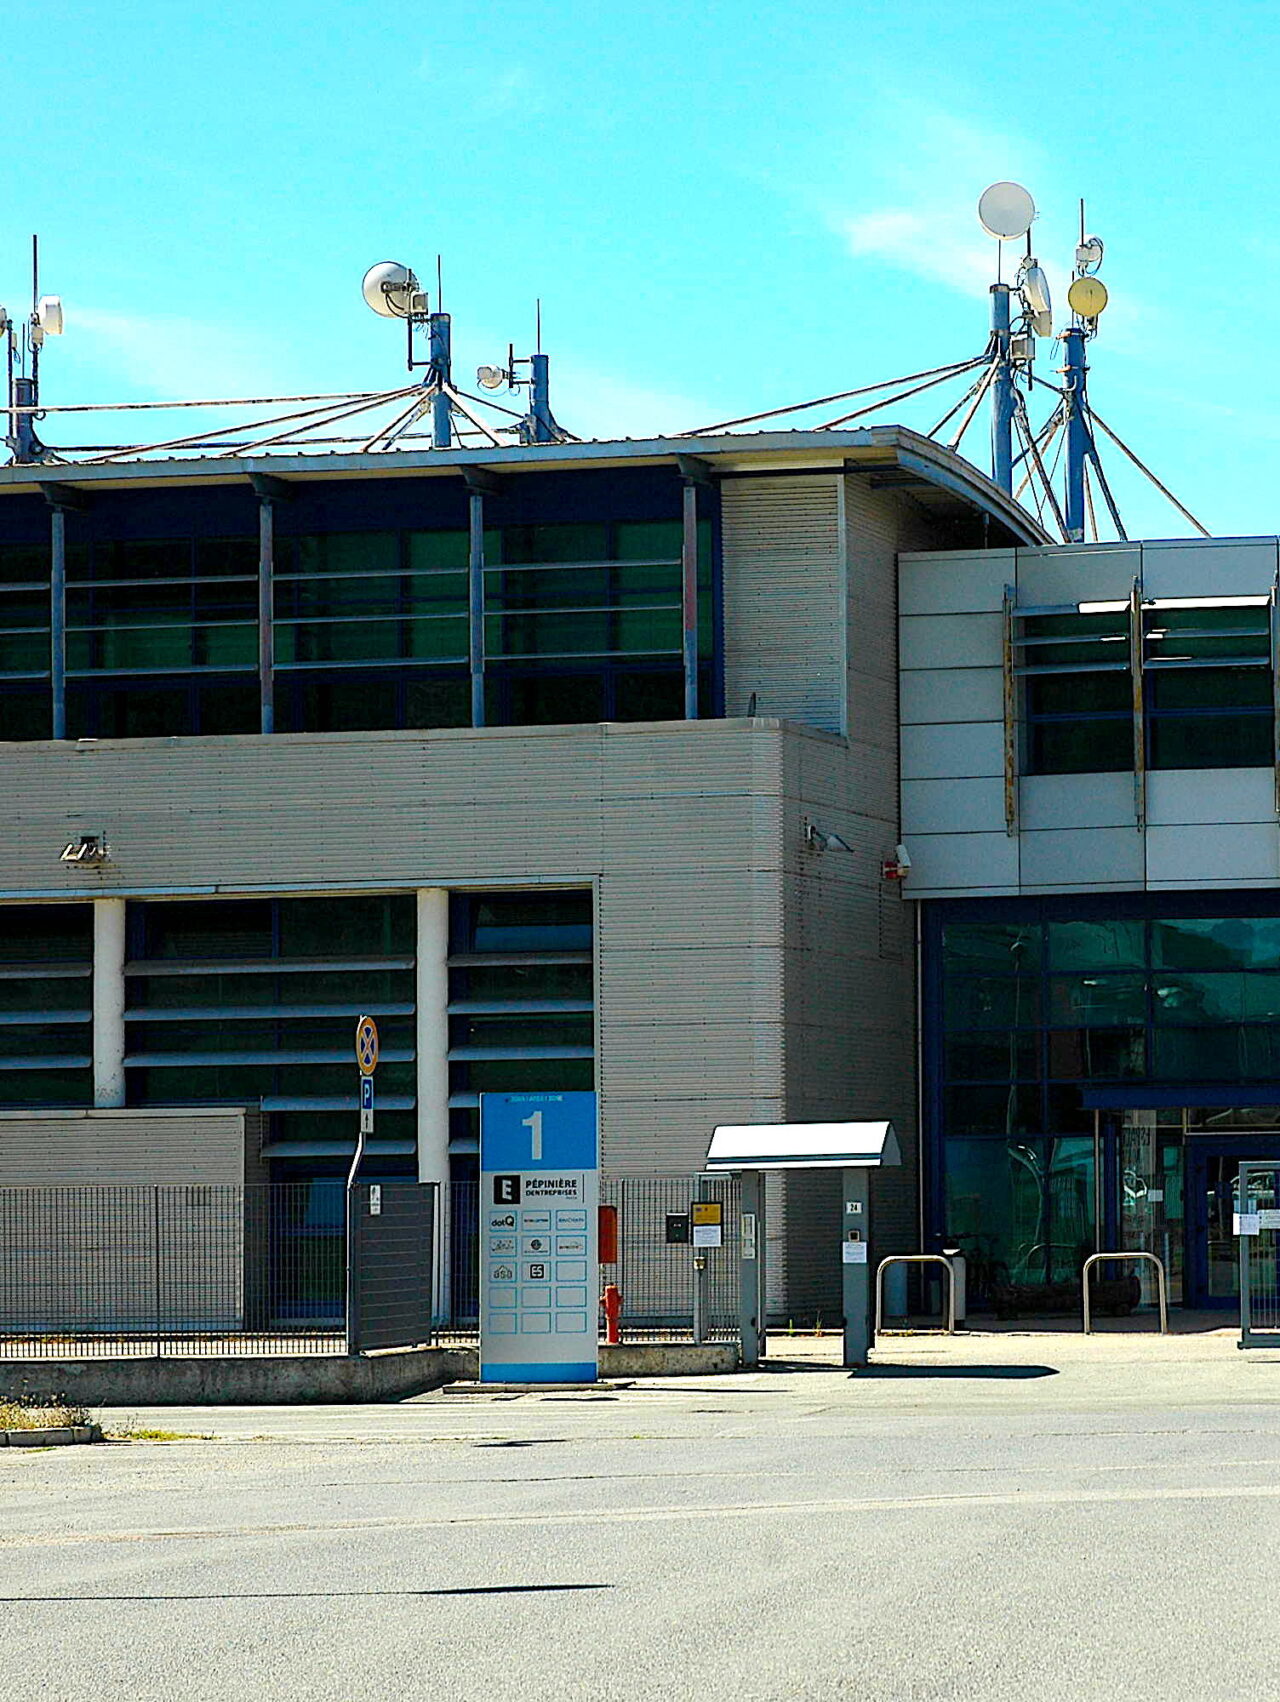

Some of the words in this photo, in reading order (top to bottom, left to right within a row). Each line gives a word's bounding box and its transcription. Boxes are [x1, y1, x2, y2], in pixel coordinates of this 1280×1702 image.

[364, 1084, 370, 1105] P
[522, 1111, 542, 1160] 1
[525, 1178, 578, 1188] PÉPINIÈRE
